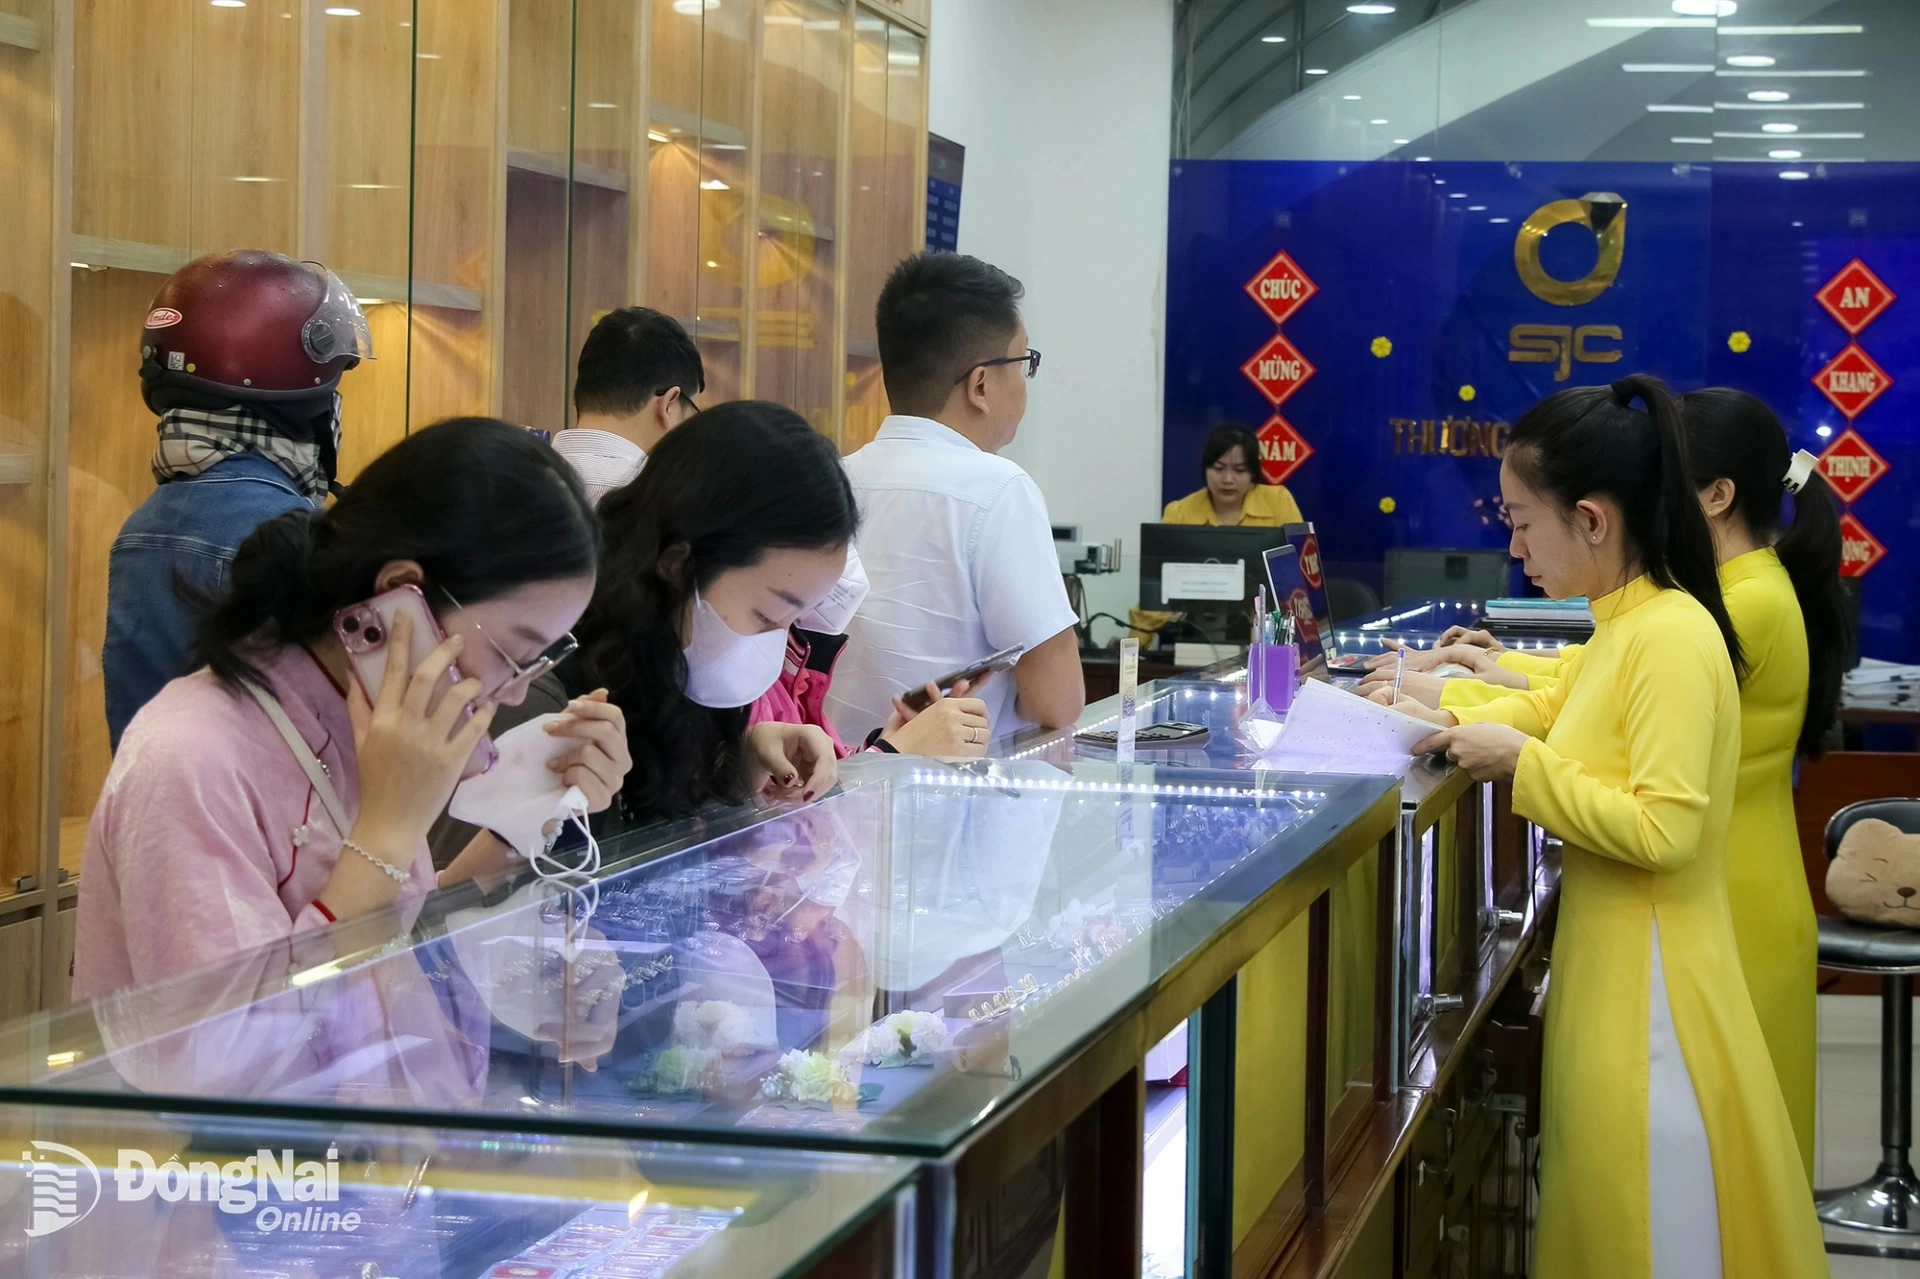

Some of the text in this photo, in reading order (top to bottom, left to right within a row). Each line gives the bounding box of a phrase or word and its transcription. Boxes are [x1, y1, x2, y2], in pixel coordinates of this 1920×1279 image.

[1260, 274, 1301, 300] CHÚC
[1839, 287, 1870, 308] AN
[1259, 355, 1300, 381] MỪNG
[1829, 371, 1874, 393] KHANG
[1259, 435, 1296, 461] NĂM
[1826, 456, 1871, 482] THỊNH
